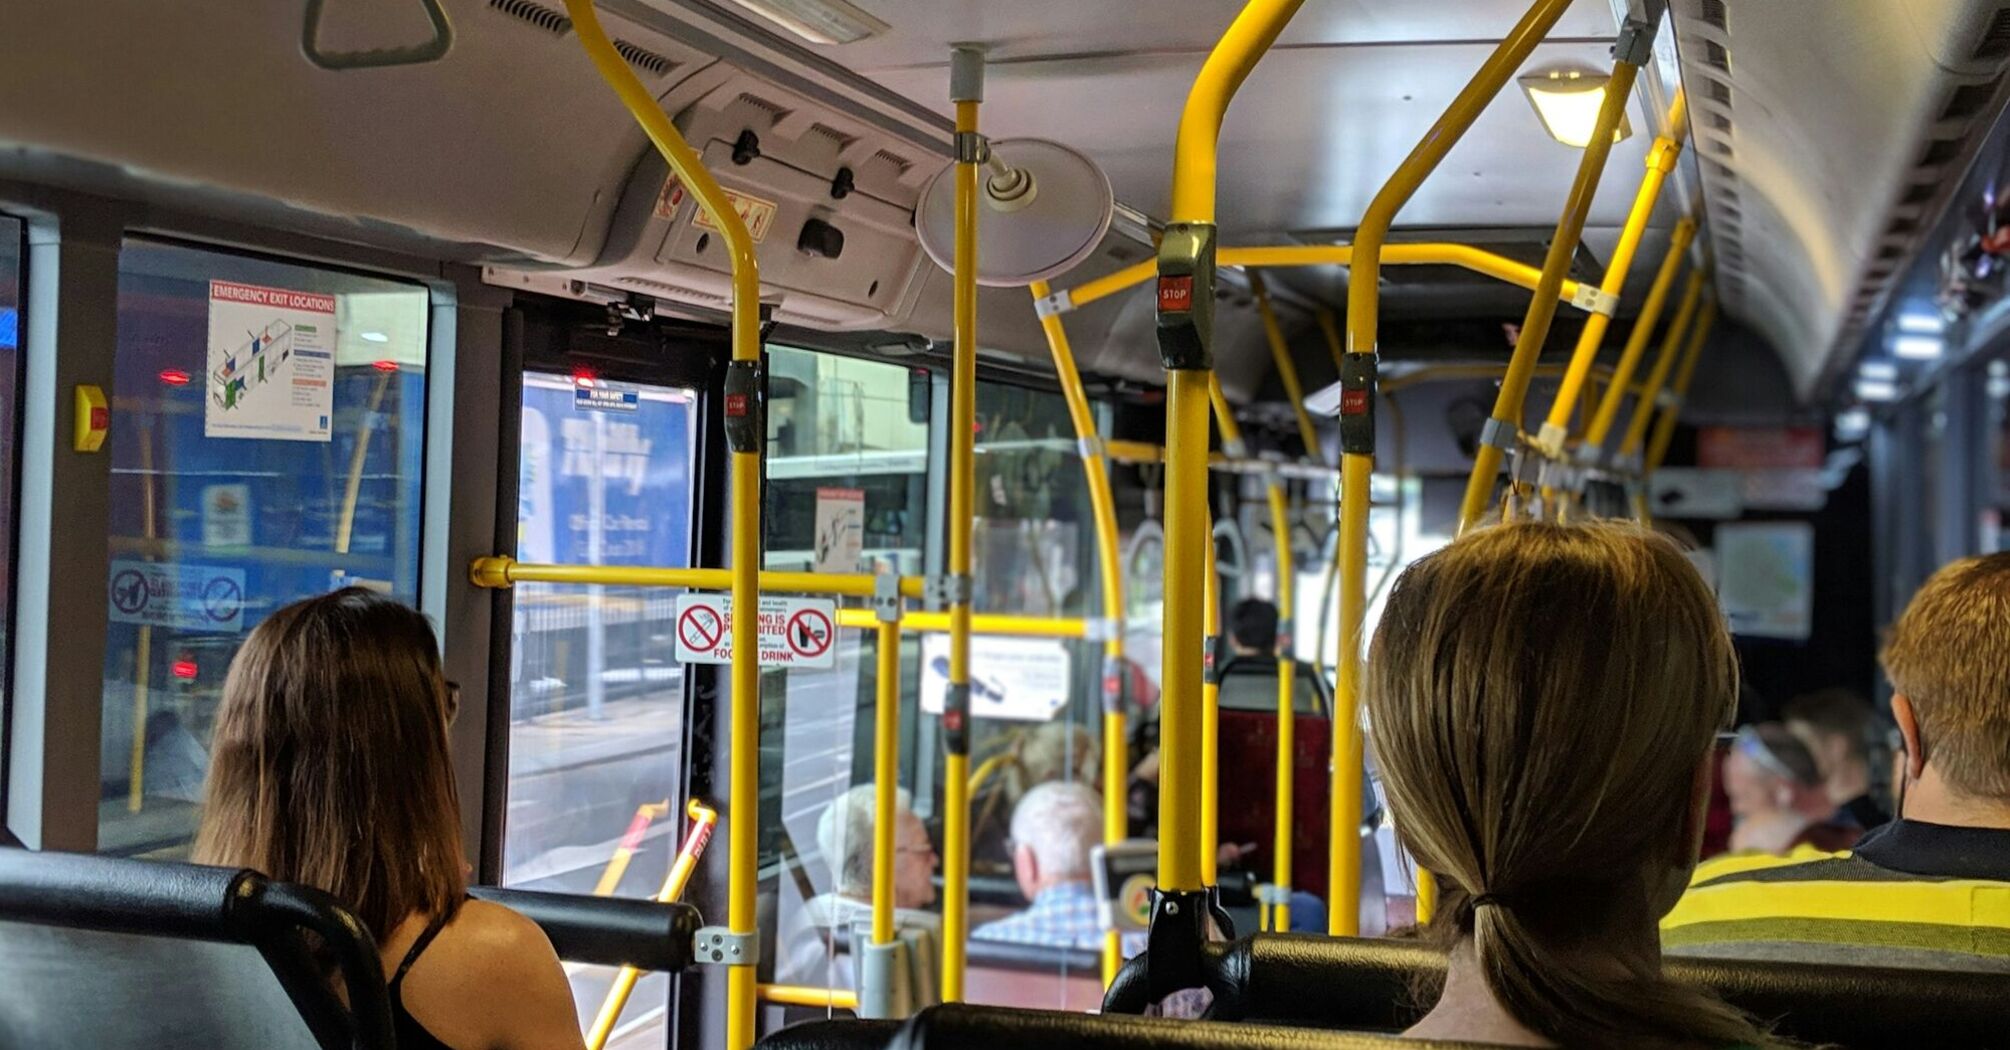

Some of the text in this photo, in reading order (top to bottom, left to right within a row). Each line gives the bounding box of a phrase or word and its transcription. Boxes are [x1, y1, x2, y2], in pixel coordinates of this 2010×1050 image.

[213, 284, 334, 312] EMERGENCY EXIT LOCATIONS
[1163, 289, 1187, 299] STOP
[1344, 397, 1364, 408] STOP
[775, 614, 785, 624] IS
[713, 649, 794, 662] FOO DRINK
